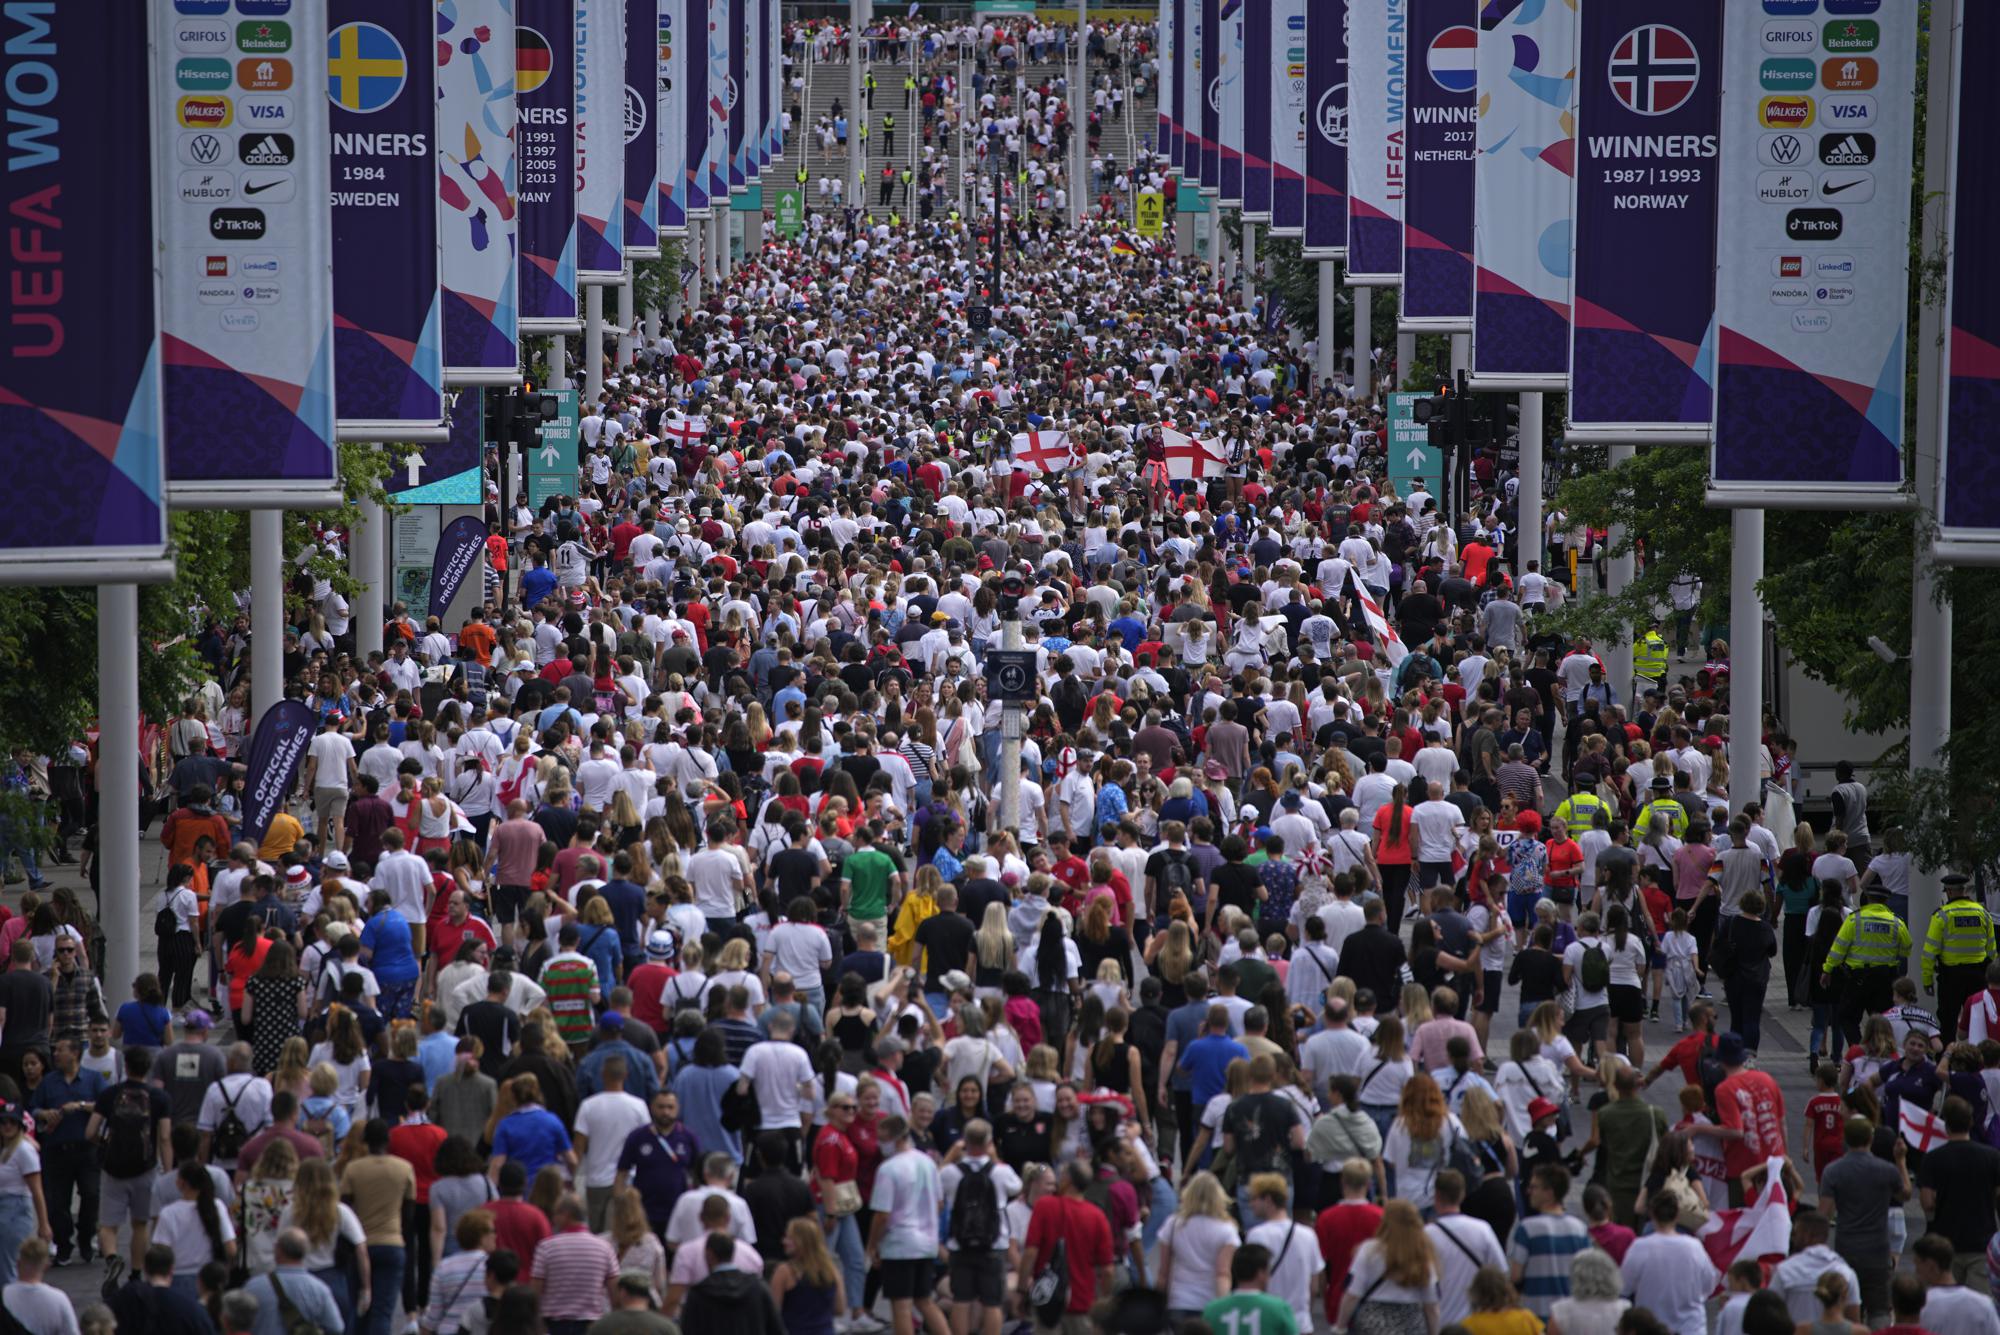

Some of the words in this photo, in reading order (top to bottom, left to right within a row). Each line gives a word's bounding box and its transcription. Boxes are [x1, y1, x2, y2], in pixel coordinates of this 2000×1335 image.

[180, 32, 226, 42] GRIFOLS
[1766, 31, 1813, 42] GRIFOLS
[242, 40, 286, 48] Heineken
[1828, 39, 1873, 48] Heineken
[178, 70, 229, 79] Hisense
[1762, 70, 1813, 79] Hisense
[4, 2, 60, 172] WOM
[184, 106, 225, 116] WALKERS
[248, 106, 284, 118] VISA
[1767, 106, 1808, 116] WALKERS
[1831, 106, 1868, 118] VISA
[526, 132, 556, 142] 1991
[1444, 132, 1474, 142] 2017
[330, 133, 427, 156] NNERS
[1588, 135, 1717, 158] WINNERS
[526, 146, 556, 156] 1997
[245, 154, 288, 164] adidas
[1826, 154, 1869, 163] adidas
[526, 160, 556, 170] 2005
[1387, 130, 1403, 200] UEFA
[343, 167, 386, 180] 1984
[526, 173, 556, 184] 2013
[1604, 170, 1645, 183] 1987
[1660, 169, 1701, 182] 1993
[183, 189, 230, 197] HUBLOT
[516, 192, 551, 202] MANY
[1761, 189, 1808, 198] HUBLOT
[330, 192, 400, 206] SWEDEN
[1614, 195, 1689, 209] NORWAY
[226, 221, 261, 230] TikTok
[1802, 221, 1838, 230] TikTok
[9, 184, 64, 358] UEFA
[208, 262, 226, 270] LEGO
[1782, 262, 1800, 270] LEGO
[1396, 431, 1409, 442] FAN
[657, 463, 664, 475] 4
[561, 550, 570, 564] 11
[439, 534, 482, 604] PROGRAMMES
[440, 542, 468, 586] OFFICIAL
[255, 738, 290, 802] OFFICIAL
[255, 726, 308, 828] PROGRAMMES
[1826, 1114, 1834, 1129] 9
[1220, 1307, 1261, 1335] 11
